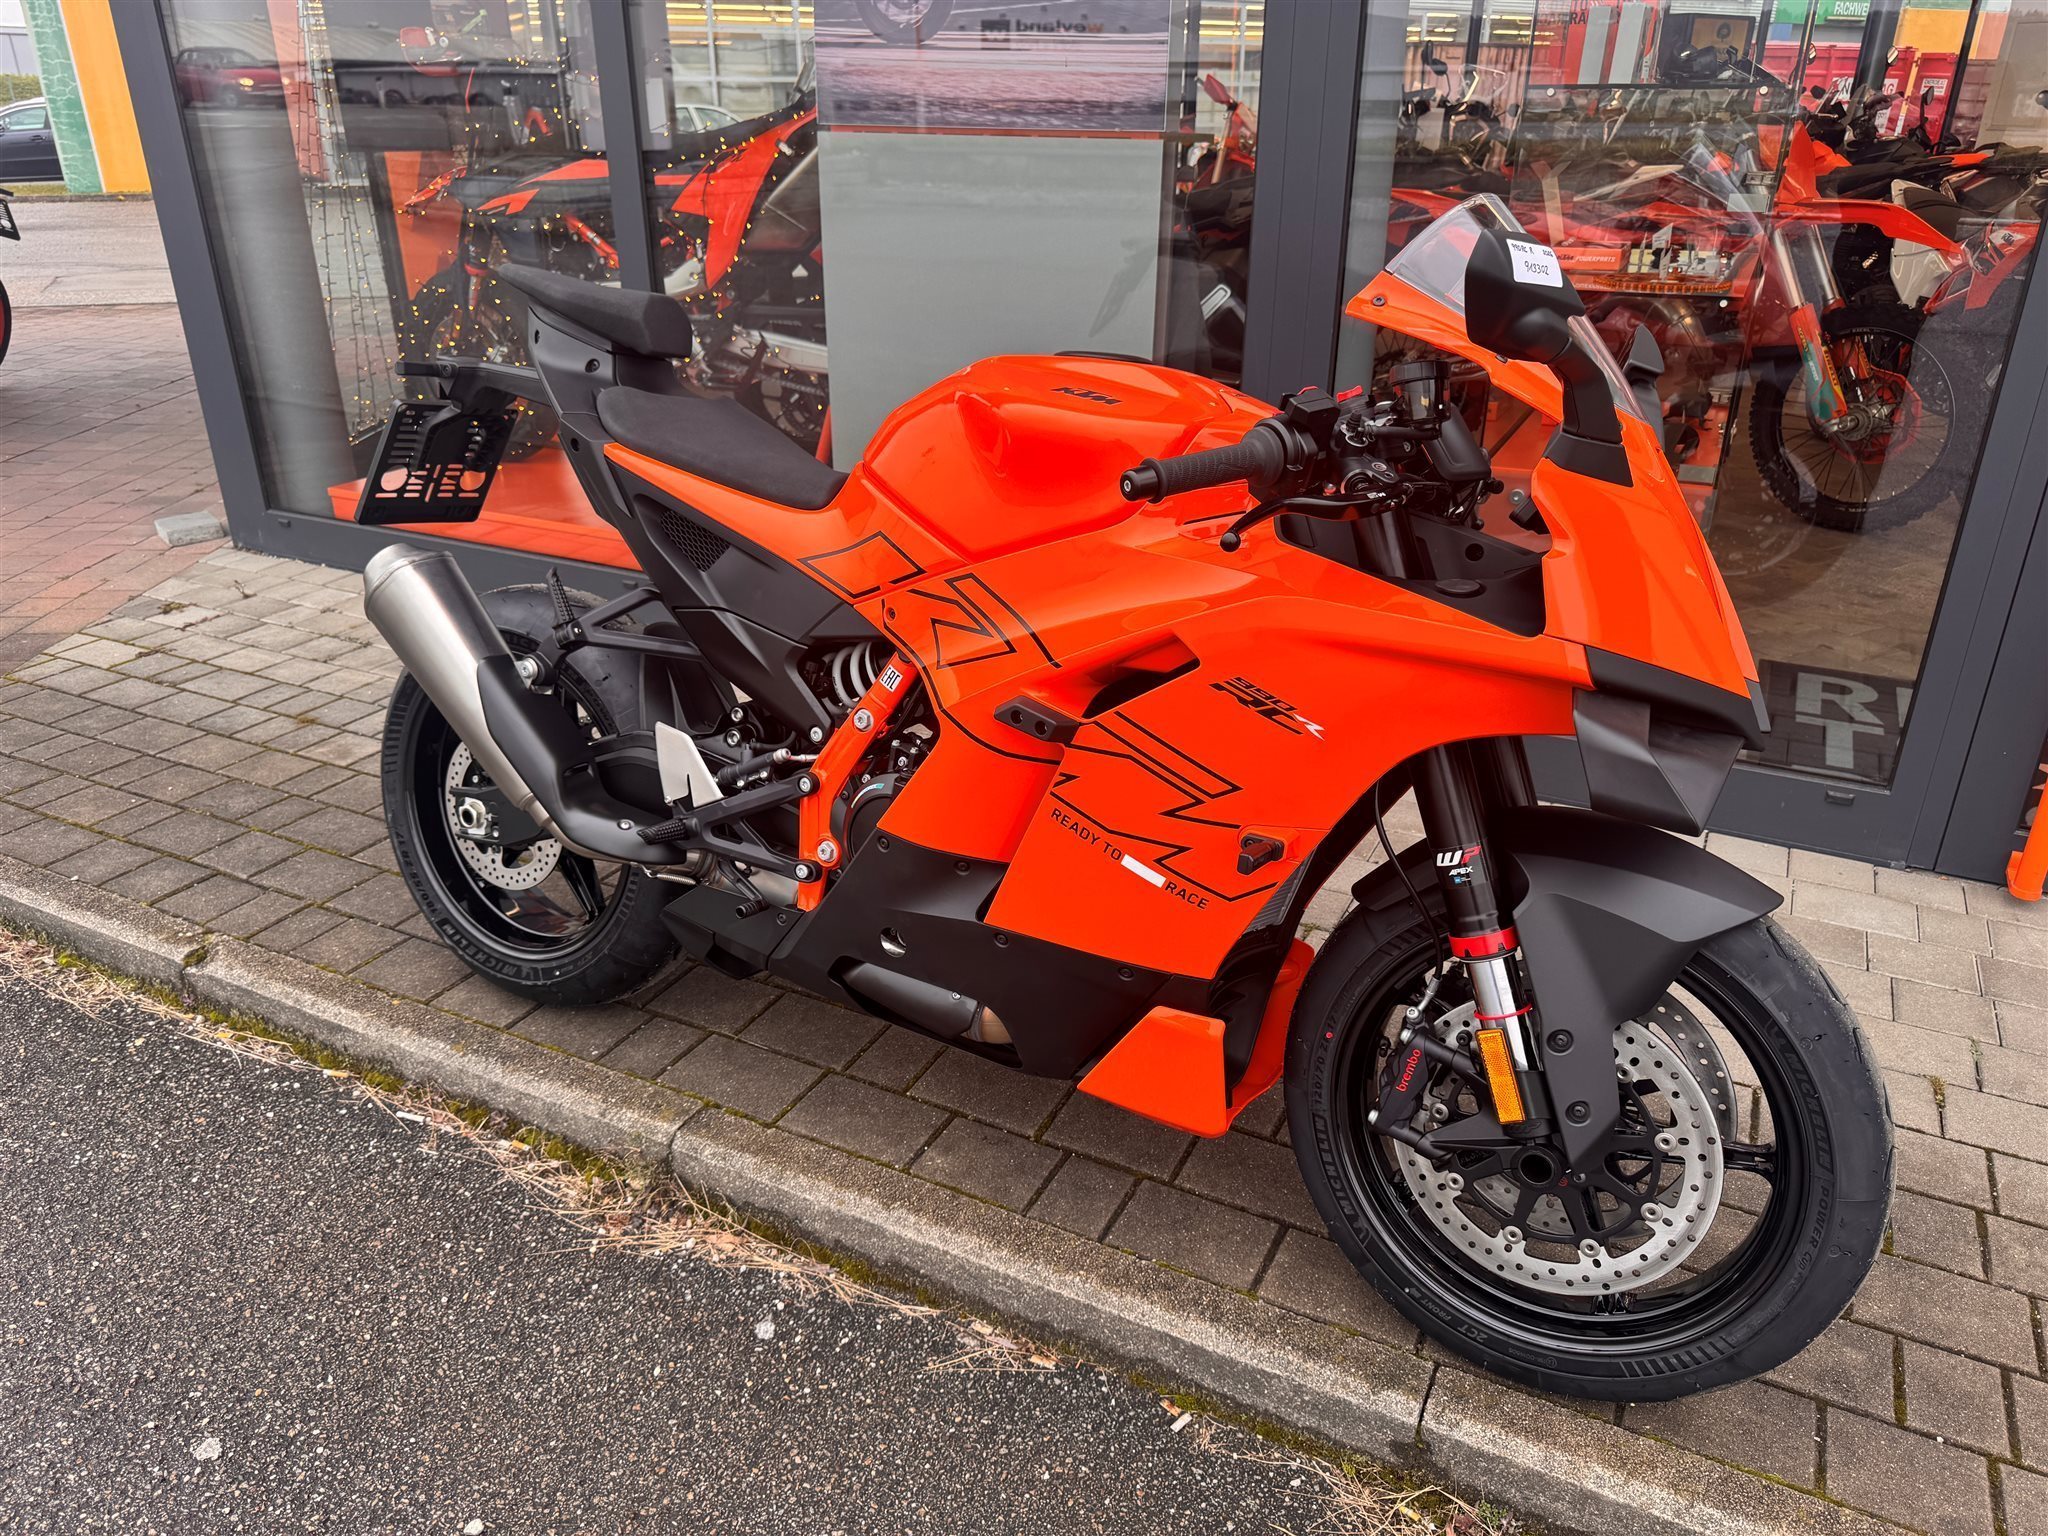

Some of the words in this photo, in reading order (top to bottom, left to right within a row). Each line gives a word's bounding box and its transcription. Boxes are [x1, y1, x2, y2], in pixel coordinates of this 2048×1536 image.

[1051, 387, 1123, 406] KTM
[1050, 807, 1101, 846] READY
[1102, 840, 1122, 861] TO
[1164, 880, 1210, 910] RACE
[1436, 845, 1482, 867] WP
[1448, 866, 1474, 876] APEX
[443, 921, 515, 977] MICHELIN
[1396, 1049, 1422, 1092] brembo
[1785, 1052, 1834, 1173] MICHELIN
[1313, 1115, 1355, 1216] MICHELIN
[1809, 1185, 1830, 1250] POWER
[1421, 1297, 1453, 1322] FRONT
[1457, 1324, 1488, 1343] 2CT
